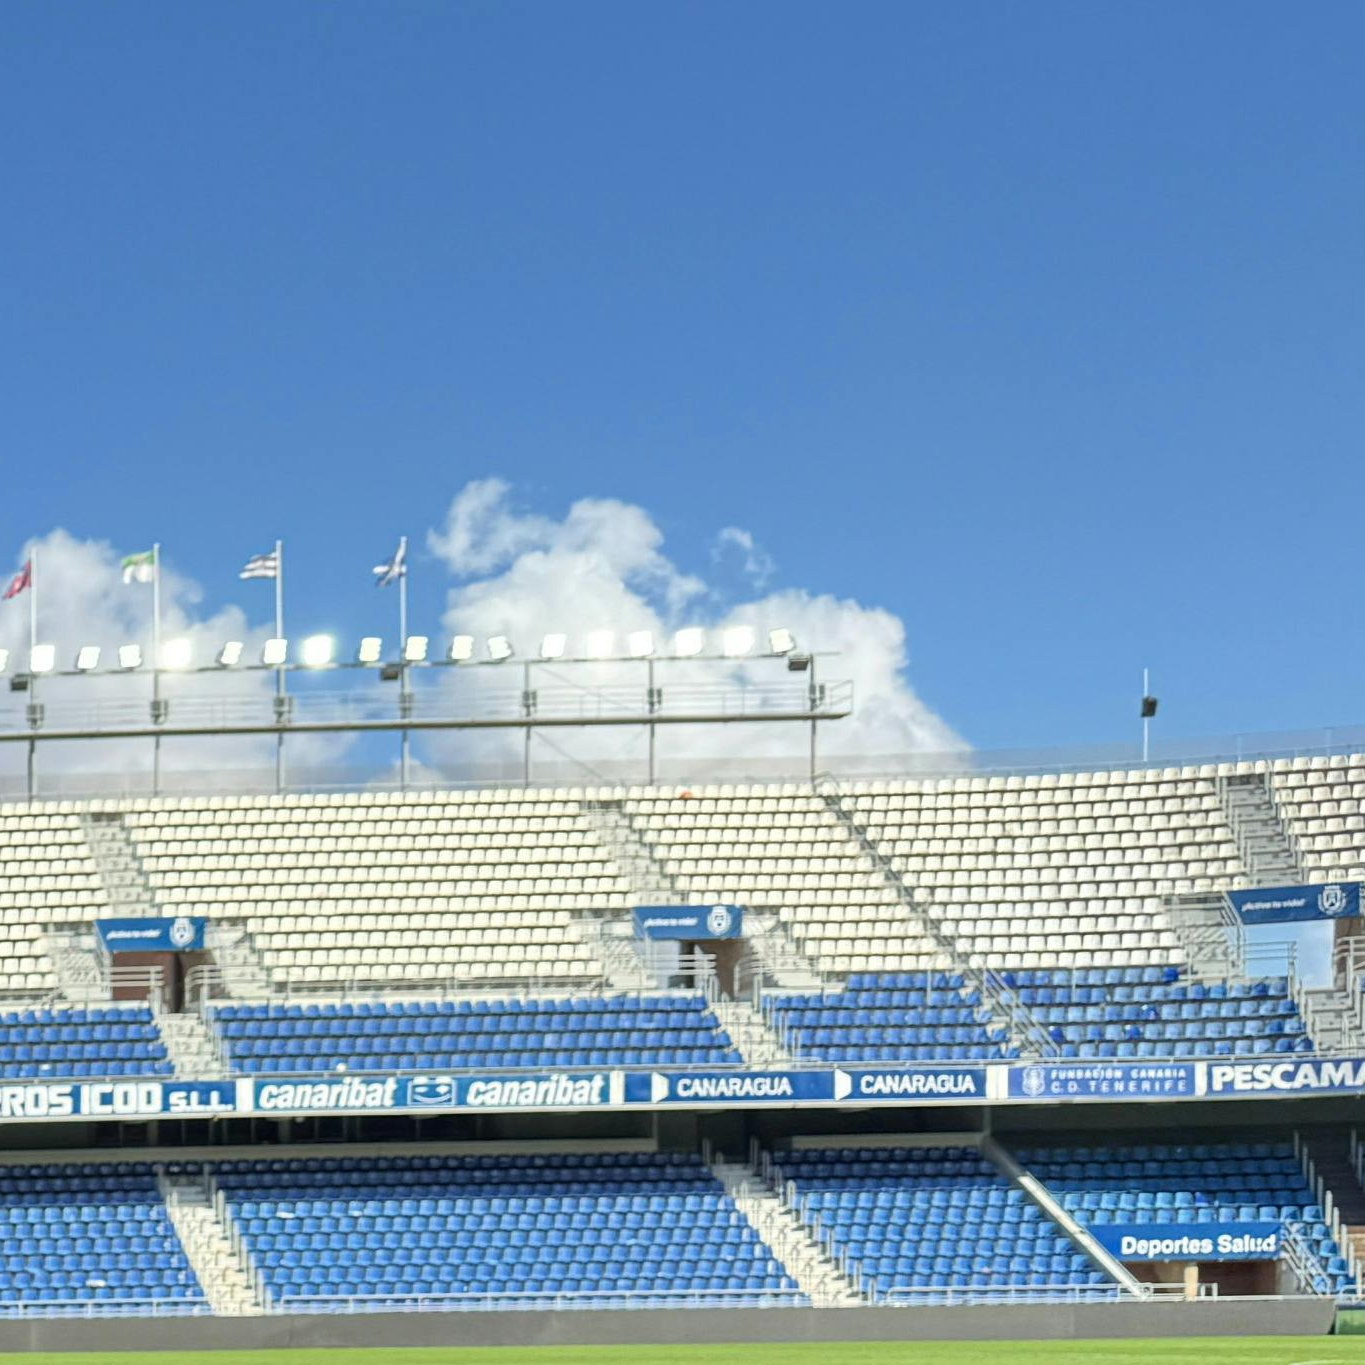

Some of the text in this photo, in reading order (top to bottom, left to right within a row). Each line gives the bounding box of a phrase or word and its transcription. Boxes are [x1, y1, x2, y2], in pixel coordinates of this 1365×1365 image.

[861, 1074, 976, 1094] CANARAGUA
[1130, 1068, 1186, 1079] CANARIA
[259, 1077, 397, 1108] canaribat
[467, 1074, 605, 1105] canaribat
[678, 1077, 793, 1097] CANARAGUA
[1089, 1080, 1186, 1093] TENERIFE
[80, 1083, 162, 1114] ICOD
[1121, 1234, 1276, 1258] Deportes Salud
